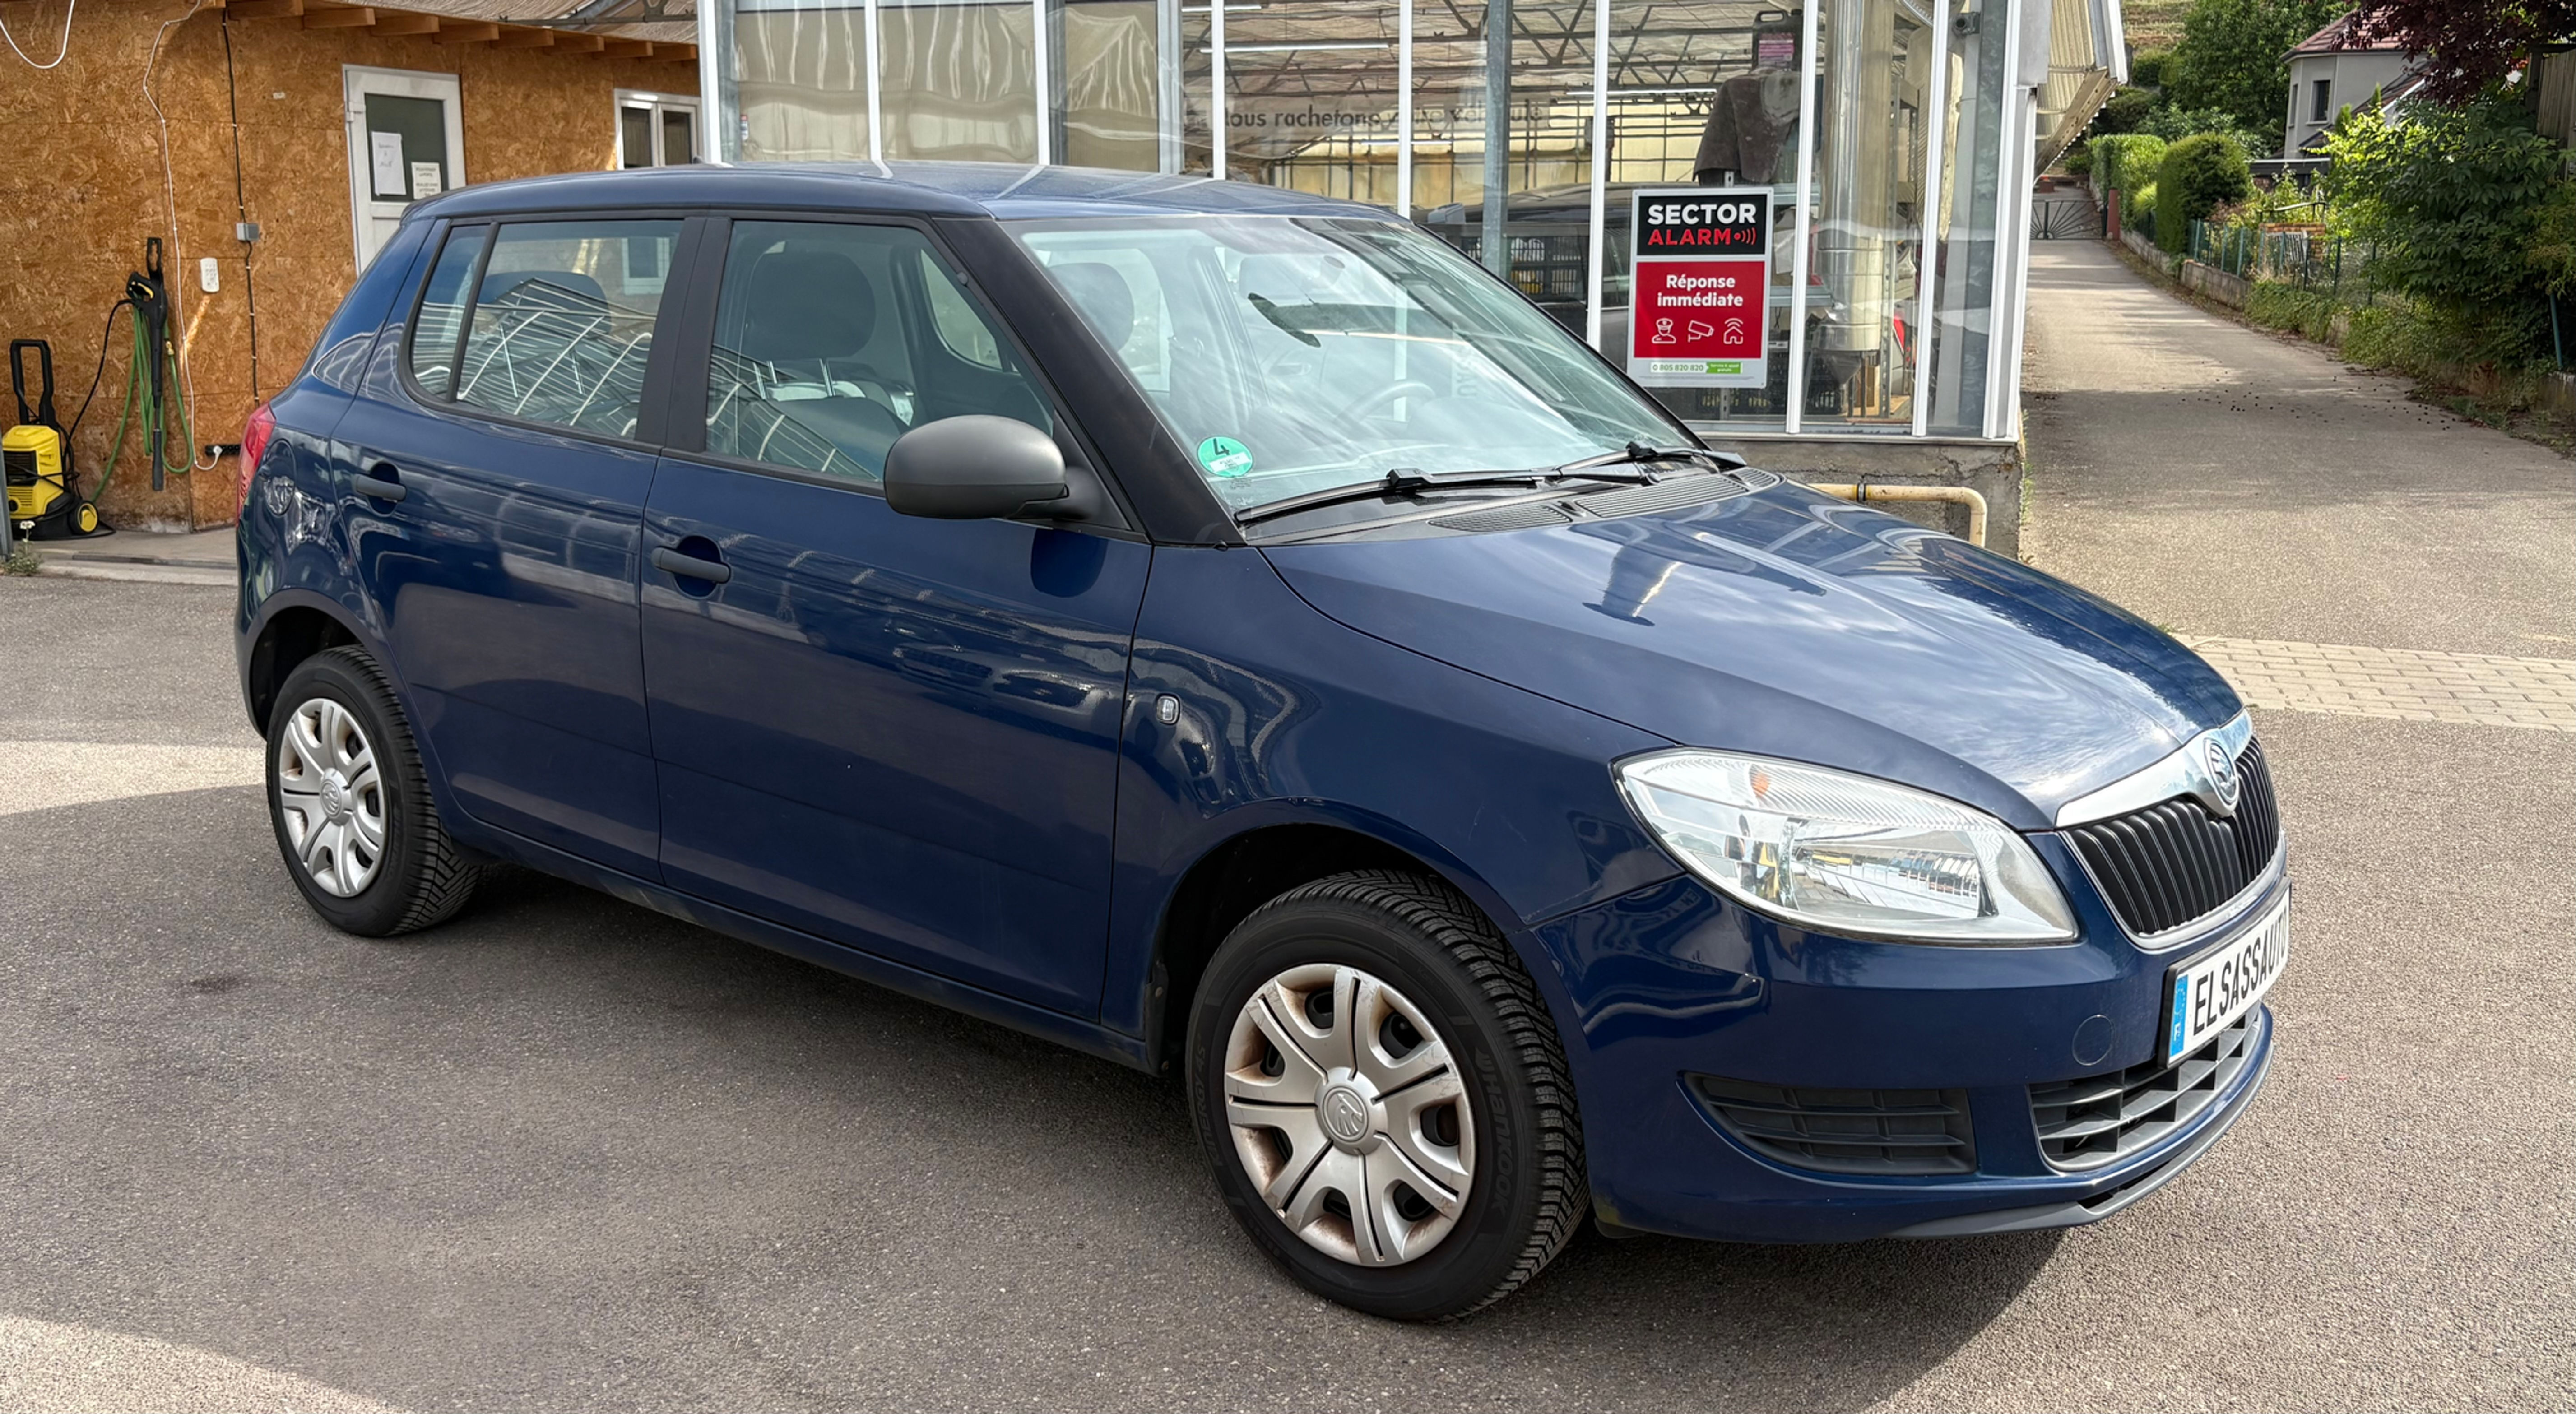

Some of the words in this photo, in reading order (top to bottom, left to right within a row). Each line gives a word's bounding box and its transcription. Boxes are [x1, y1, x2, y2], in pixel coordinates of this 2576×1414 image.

[1275, 104, 1381, 127] rachetons
[1648, 204, 1756, 225] SECTOR
[1648, 228, 1731, 245] ALARM
[1666, 274, 1736, 292] Réponse
[1657, 292, 1744, 306] immédiate
[1213, 438, 1230, 455] 4
[2193, 906, 2287, 1036] ELSASSAUTO
